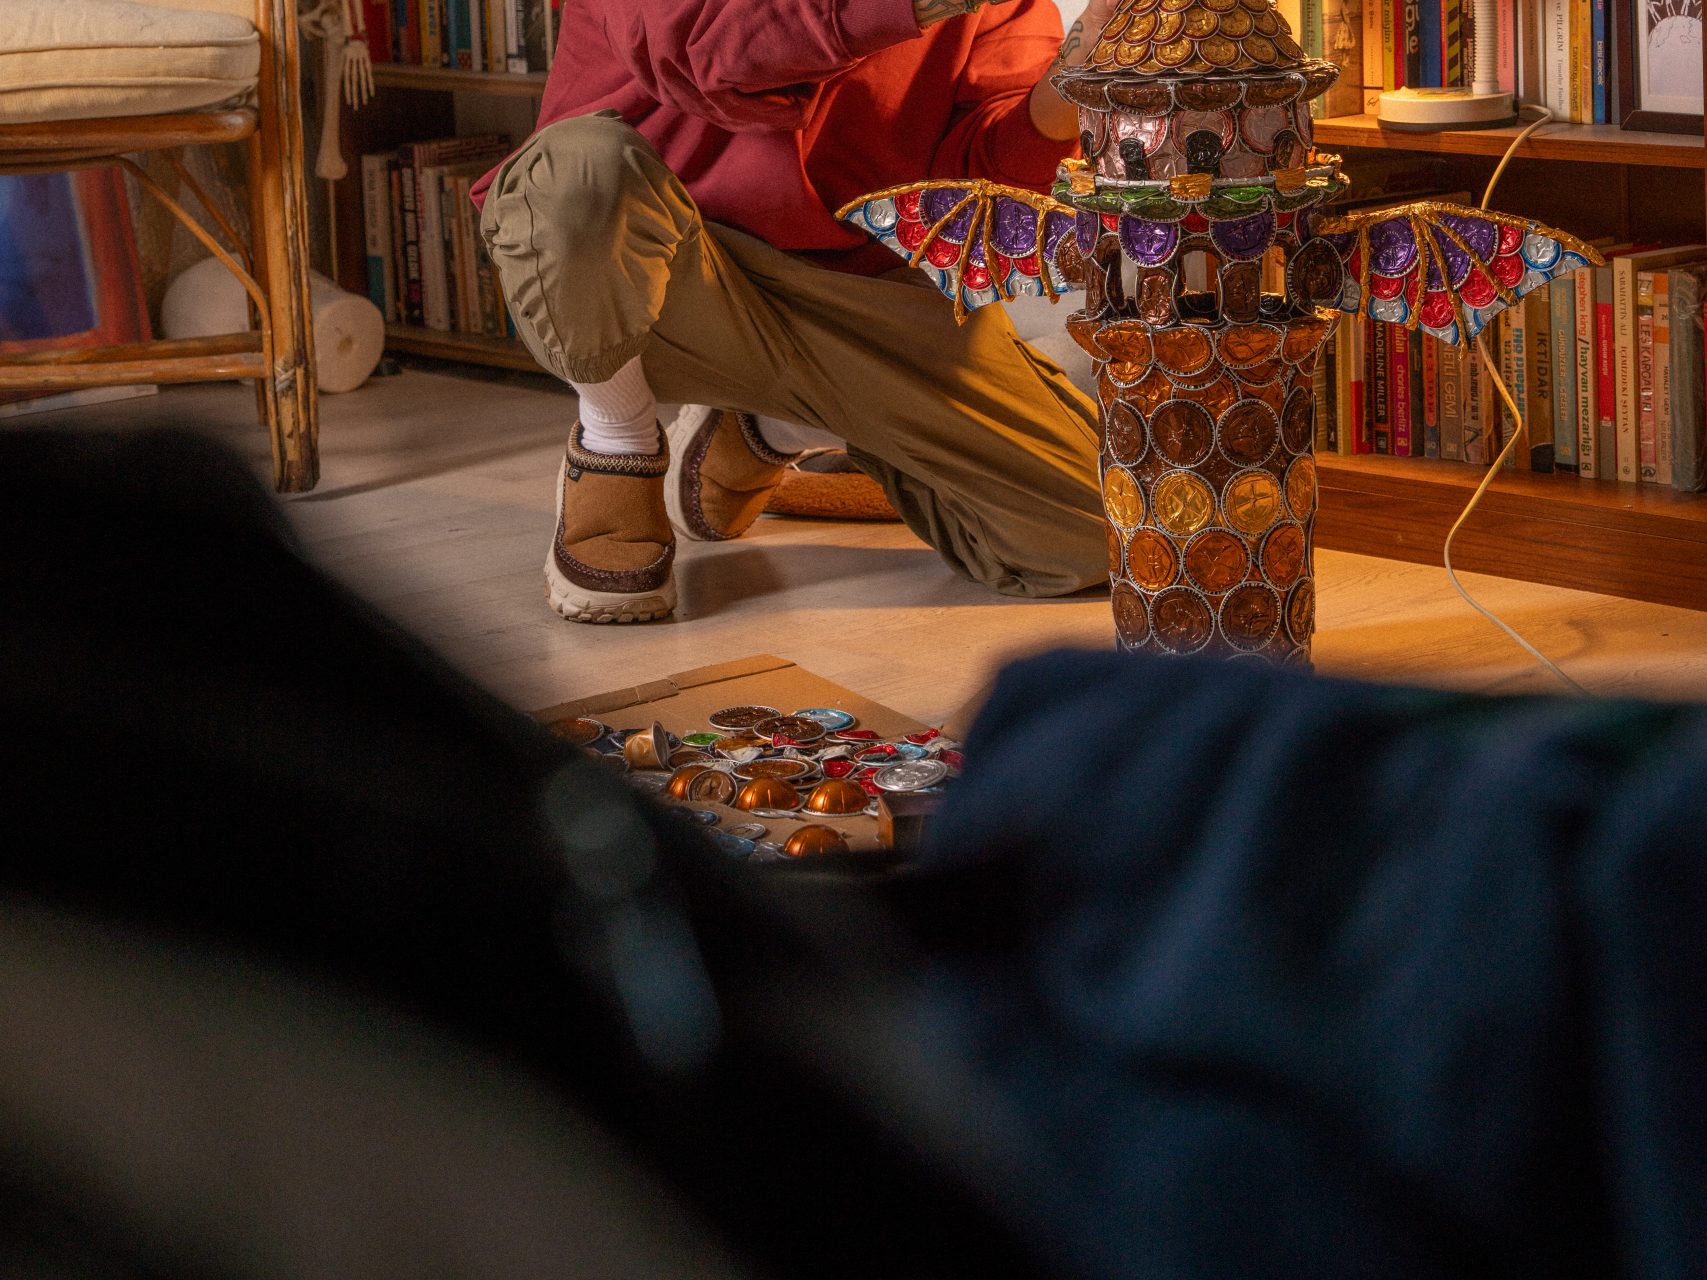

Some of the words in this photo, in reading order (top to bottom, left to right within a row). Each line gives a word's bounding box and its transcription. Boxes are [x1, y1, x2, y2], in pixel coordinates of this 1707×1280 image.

[1577, 271, 1588, 313] stephen
[1619, 270, 1628, 321] SABAHATTİN
[1578, 314, 1588, 337] king
[1374, 322, 1385, 377] MADELINE
[1396, 364, 1406, 399] charles
[1579, 346, 1590, 393] hayvan
[1619, 345, 1629, 397] İÇİMİZDEKİ
[1375, 380, 1386, 417] MILLER
[1397, 401, 1408, 433] berlitz
[1444, 381, 1458, 418] GEMİ
[1621, 398, 1630, 434] ŞEYTAN
[1580, 396, 1592, 458] mezarlığı
